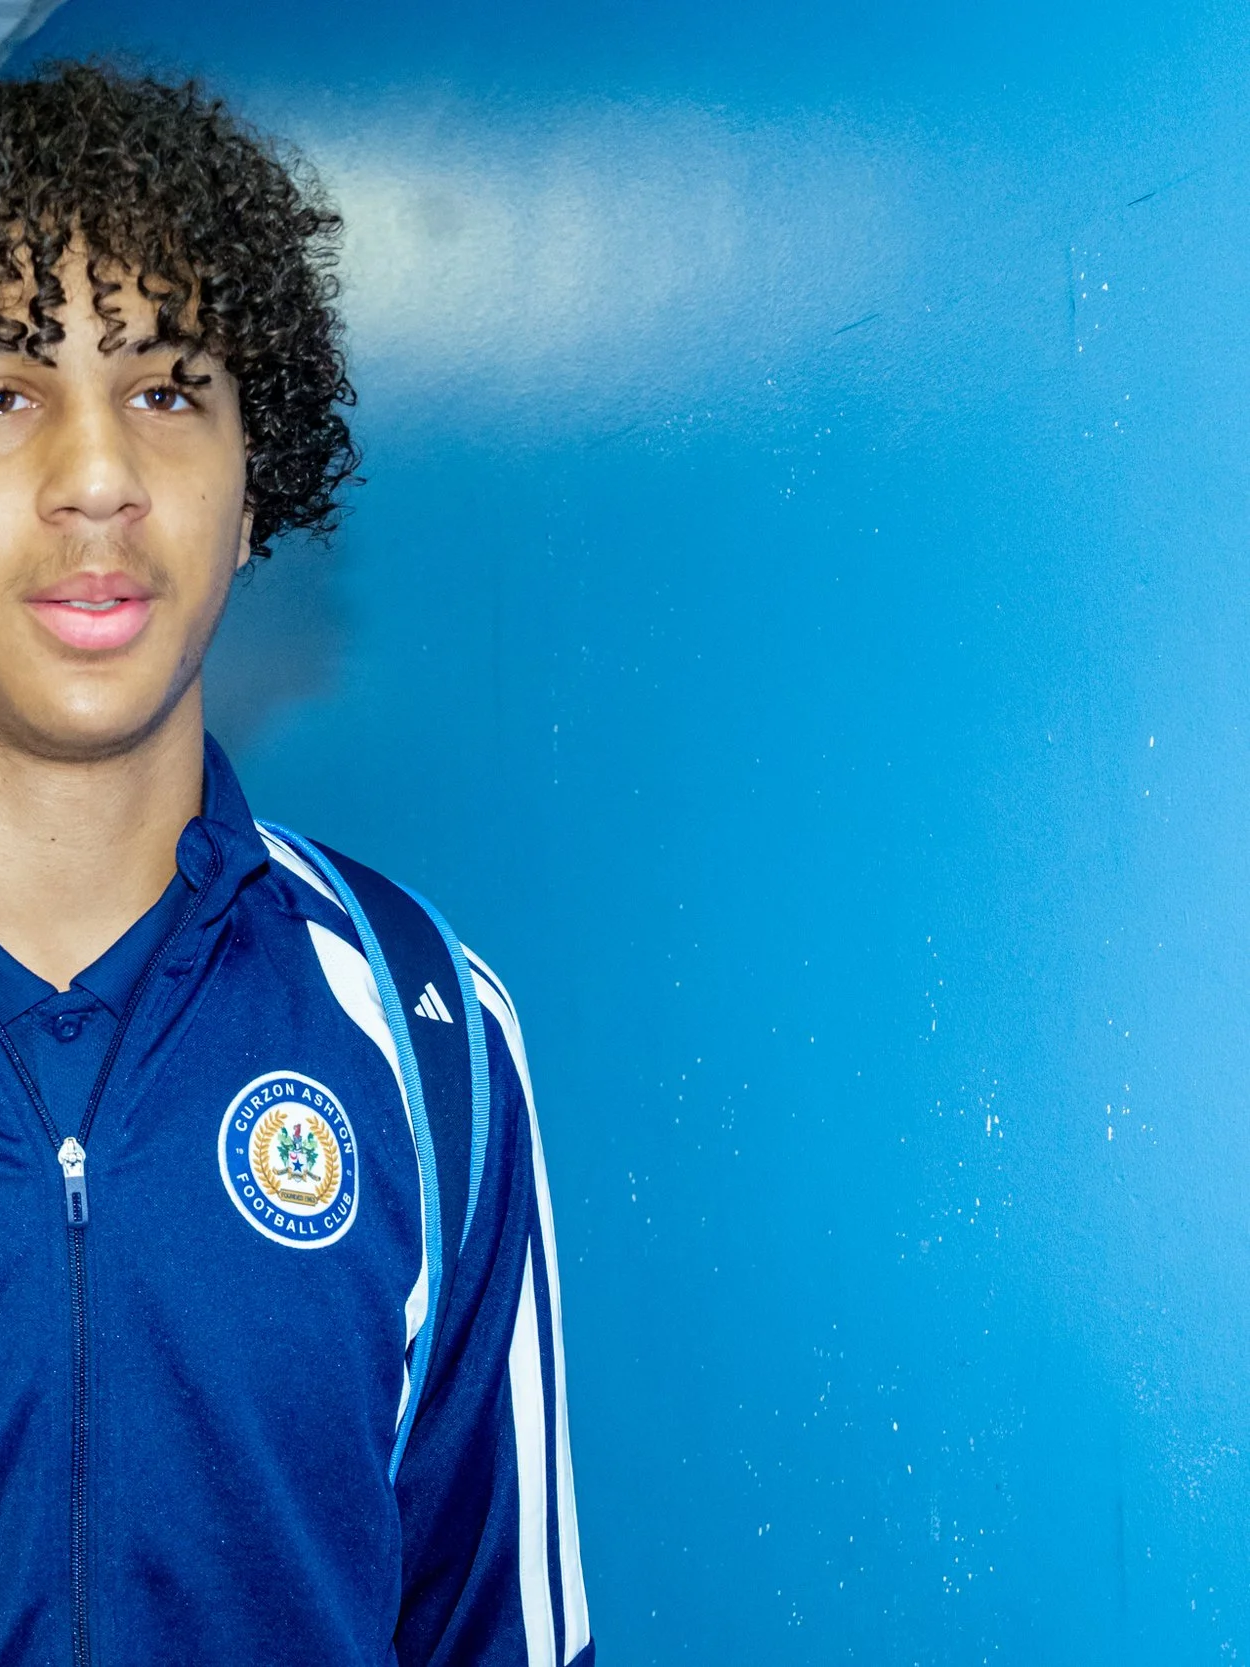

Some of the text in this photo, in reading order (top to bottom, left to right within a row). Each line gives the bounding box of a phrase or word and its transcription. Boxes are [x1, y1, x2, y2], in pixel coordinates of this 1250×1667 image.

[235, 1083, 353, 1154] CURZON ASHTON
[236, 1172, 352, 1235] FOOTBALL CLUB
